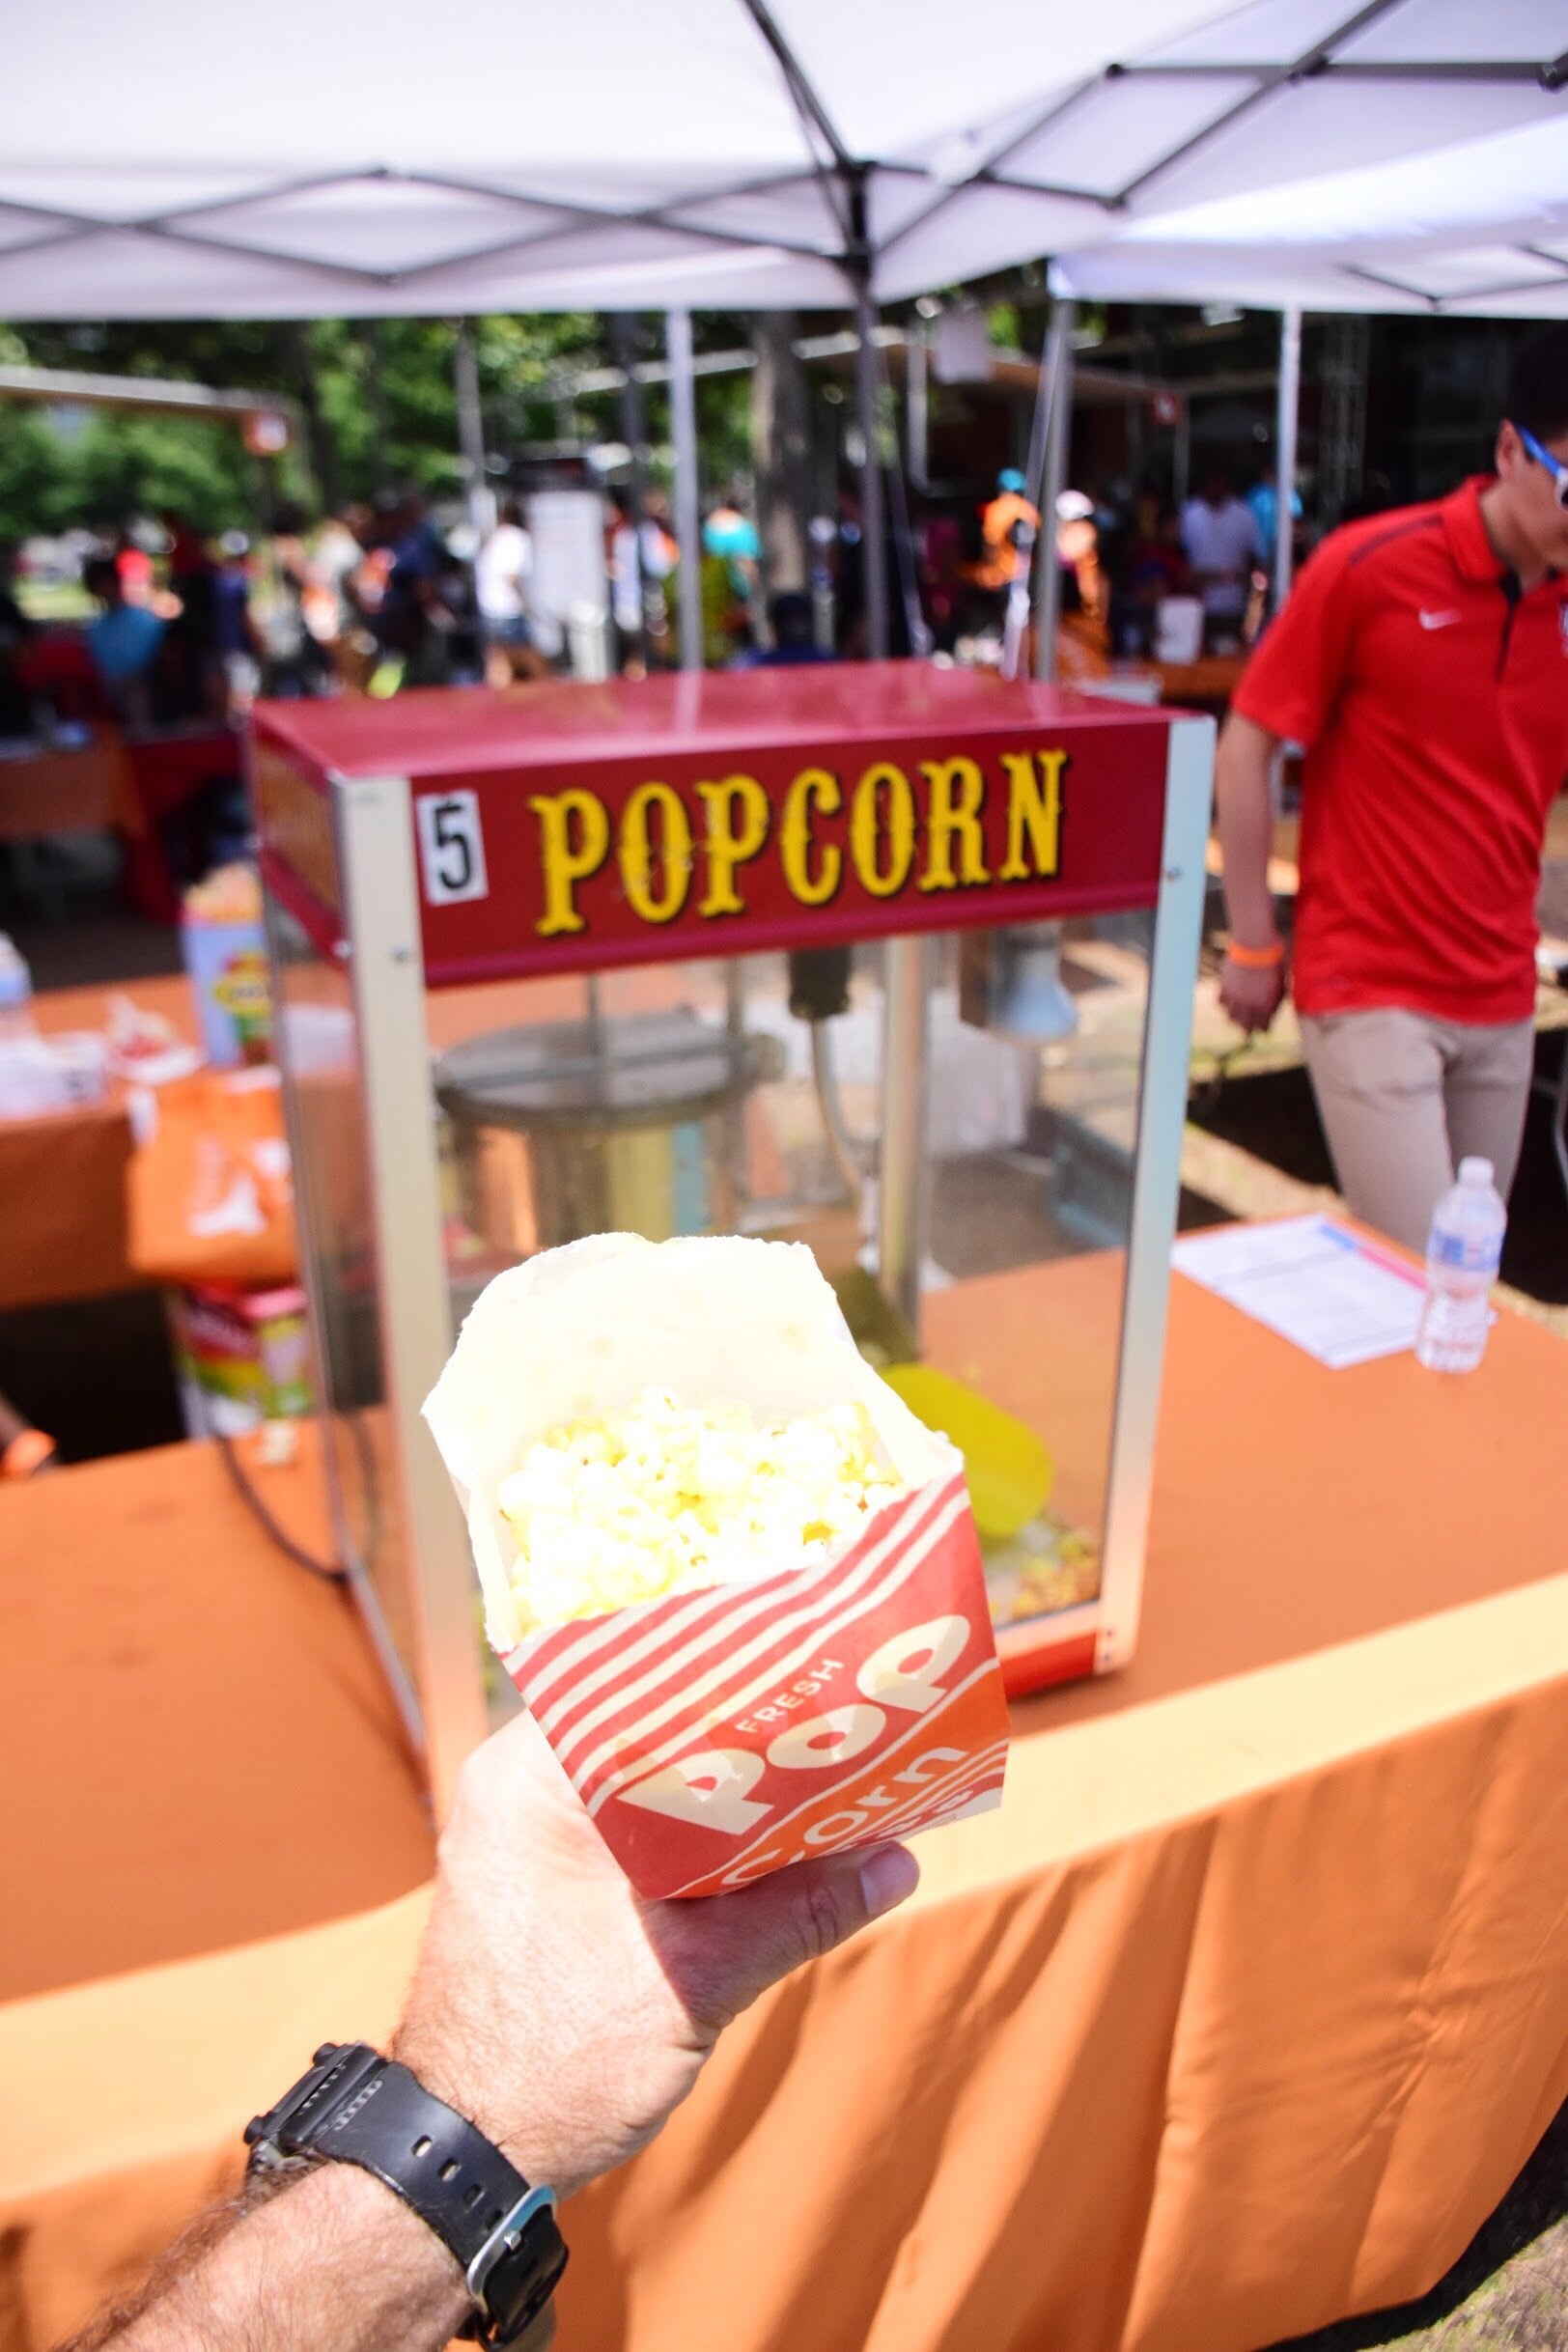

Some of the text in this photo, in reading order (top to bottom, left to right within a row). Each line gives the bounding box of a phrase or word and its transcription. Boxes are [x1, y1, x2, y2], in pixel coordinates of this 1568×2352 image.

[434, 800, 471, 889] 5
[530, 749, 1066, 937] POPCORN
[737, 1659, 845, 1734] FRESH
